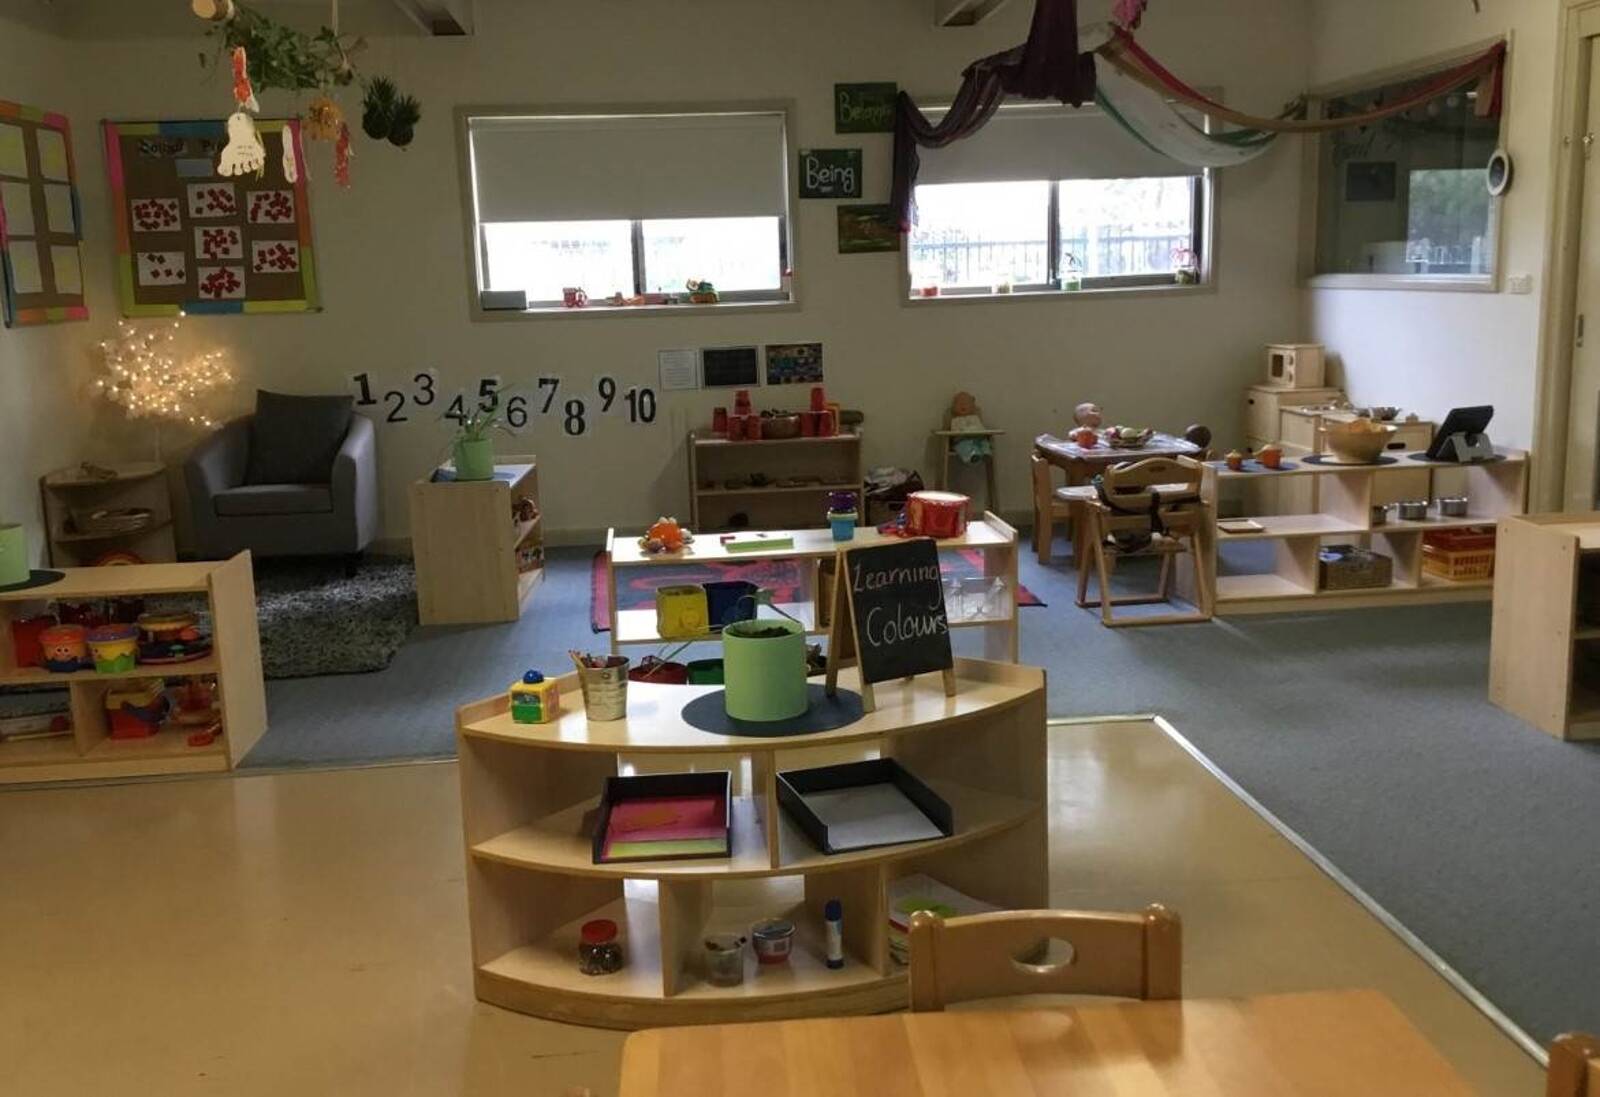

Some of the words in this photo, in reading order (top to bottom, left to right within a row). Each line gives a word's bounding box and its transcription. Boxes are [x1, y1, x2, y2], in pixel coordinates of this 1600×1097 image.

[806, 156, 855, 193] Being
[353, 373, 377, 405] 1
[384, 391, 408, 423] 2
[413, 373, 435, 406] 3
[445, 394, 466, 426] 4
[478, 379, 499, 413] 5
[506, 396, 528, 427] 6
[538, 378, 560, 414] 7
[564, 399, 586, 436] 8
[599, 376, 617, 413] 9
[624, 388, 657, 423] 10
[853, 563, 942, 610] Learning
[867, 601, 948, 647] Colours
